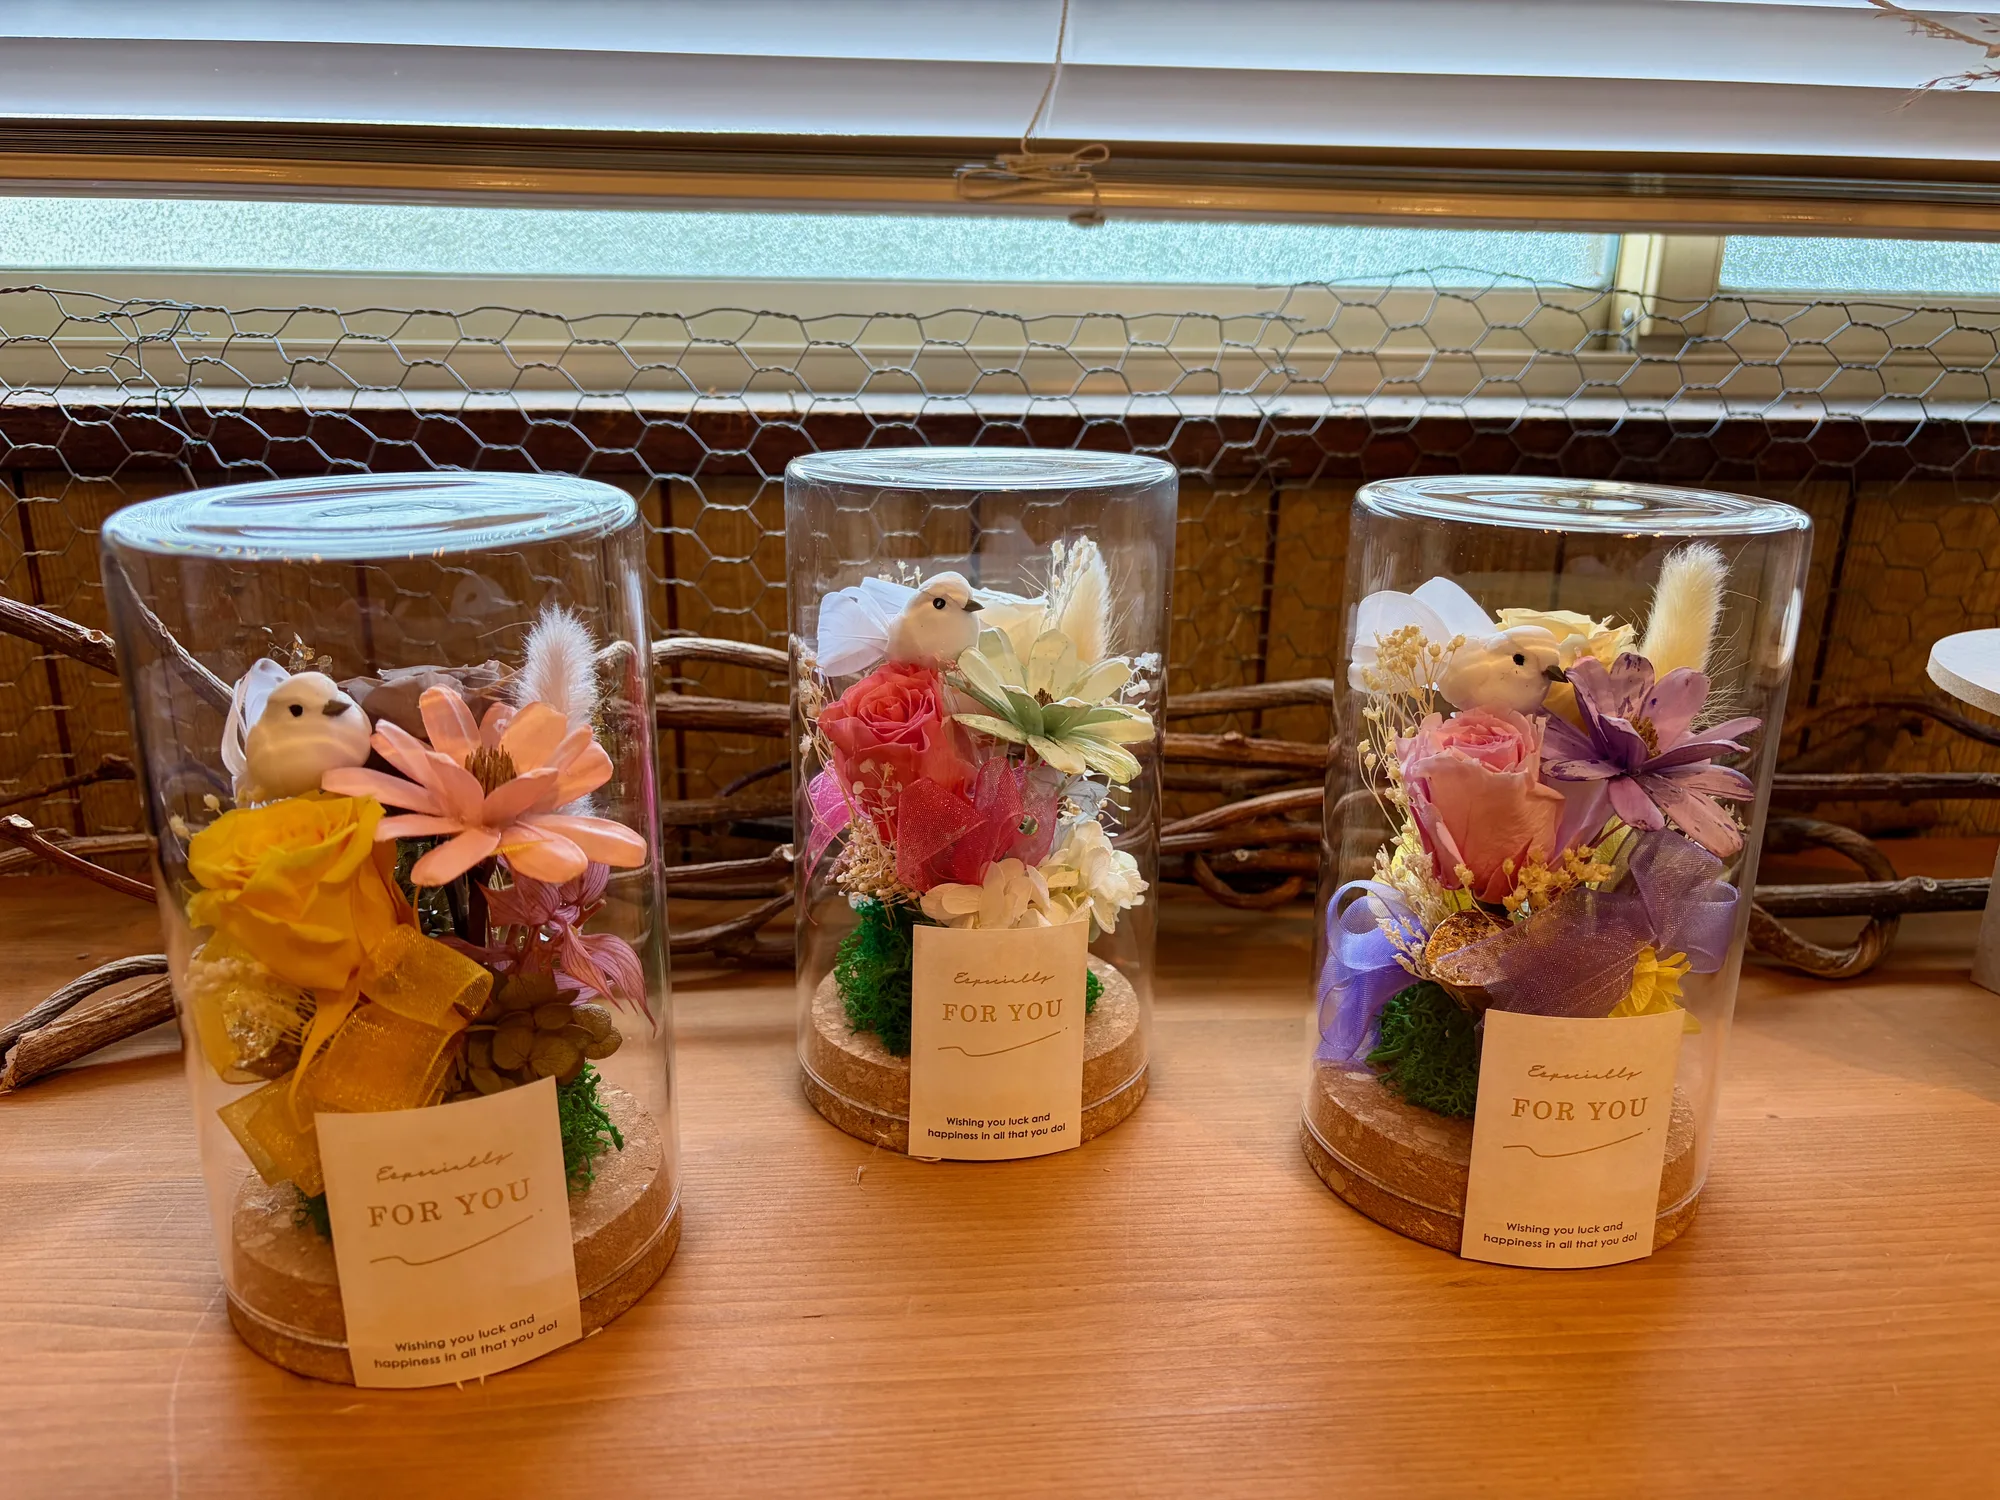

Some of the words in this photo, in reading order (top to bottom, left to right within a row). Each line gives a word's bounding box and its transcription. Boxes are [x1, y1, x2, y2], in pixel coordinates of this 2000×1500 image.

[953, 971, 1055, 987] Especially
[942, 1003, 997, 1023] FOR
[1008, 999, 1063, 1022] YOU
[1527, 1064, 1642, 1081] Especially
[1511, 1097, 1575, 1121] FOR
[1587, 1096, 1649, 1121] YOU
[946, 1117, 984, 1128] Wishing
[987, 1118, 1006, 1128] you
[1008, 1117, 1029, 1126] luck
[1031, 1113, 1051, 1123] and
[927, 1129, 979, 1140] happiness
[981, 1131, 990, 1140] in
[993, 1130, 1005, 1140] all
[1008, 1129, 1028, 1139] that
[1031, 1127, 1048, 1138] you
[1050, 1123, 1066, 1133] do!
[376, 1151, 513, 1183] Especially
[367, 1200, 442, 1227] FOR
[455, 1178, 530, 1216] YOU
[1506, 1222, 1550, 1236] Wishing
[1553, 1225, 1575, 1236] you
[1577, 1223, 1600, 1234] luck
[1603, 1221, 1623, 1232] and
[1483, 1233, 1542, 1249] happiness
[1545, 1239, 1556, 1249] in
[1559, 1239, 1573, 1249] all
[1576, 1238, 1598, 1248] that
[1600, 1237, 1619, 1248] you
[1622, 1232, 1637, 1243] do!
[395, 1337, 446, 1352] Wishing
[450, 1333, 474, 1347] you
[478, 1324, 506, 1339] luck
[510, 1314, 535, 1330] and
[374, 1355, 441, 1370] happiness
[445, 1352, 456, 1362] in
[461, 1348, 476, 1359] all
[481, 1340, 507, 1355] that
[511, 1331, 534, 1347] you
[538, 1320, 558, 1336] do!
